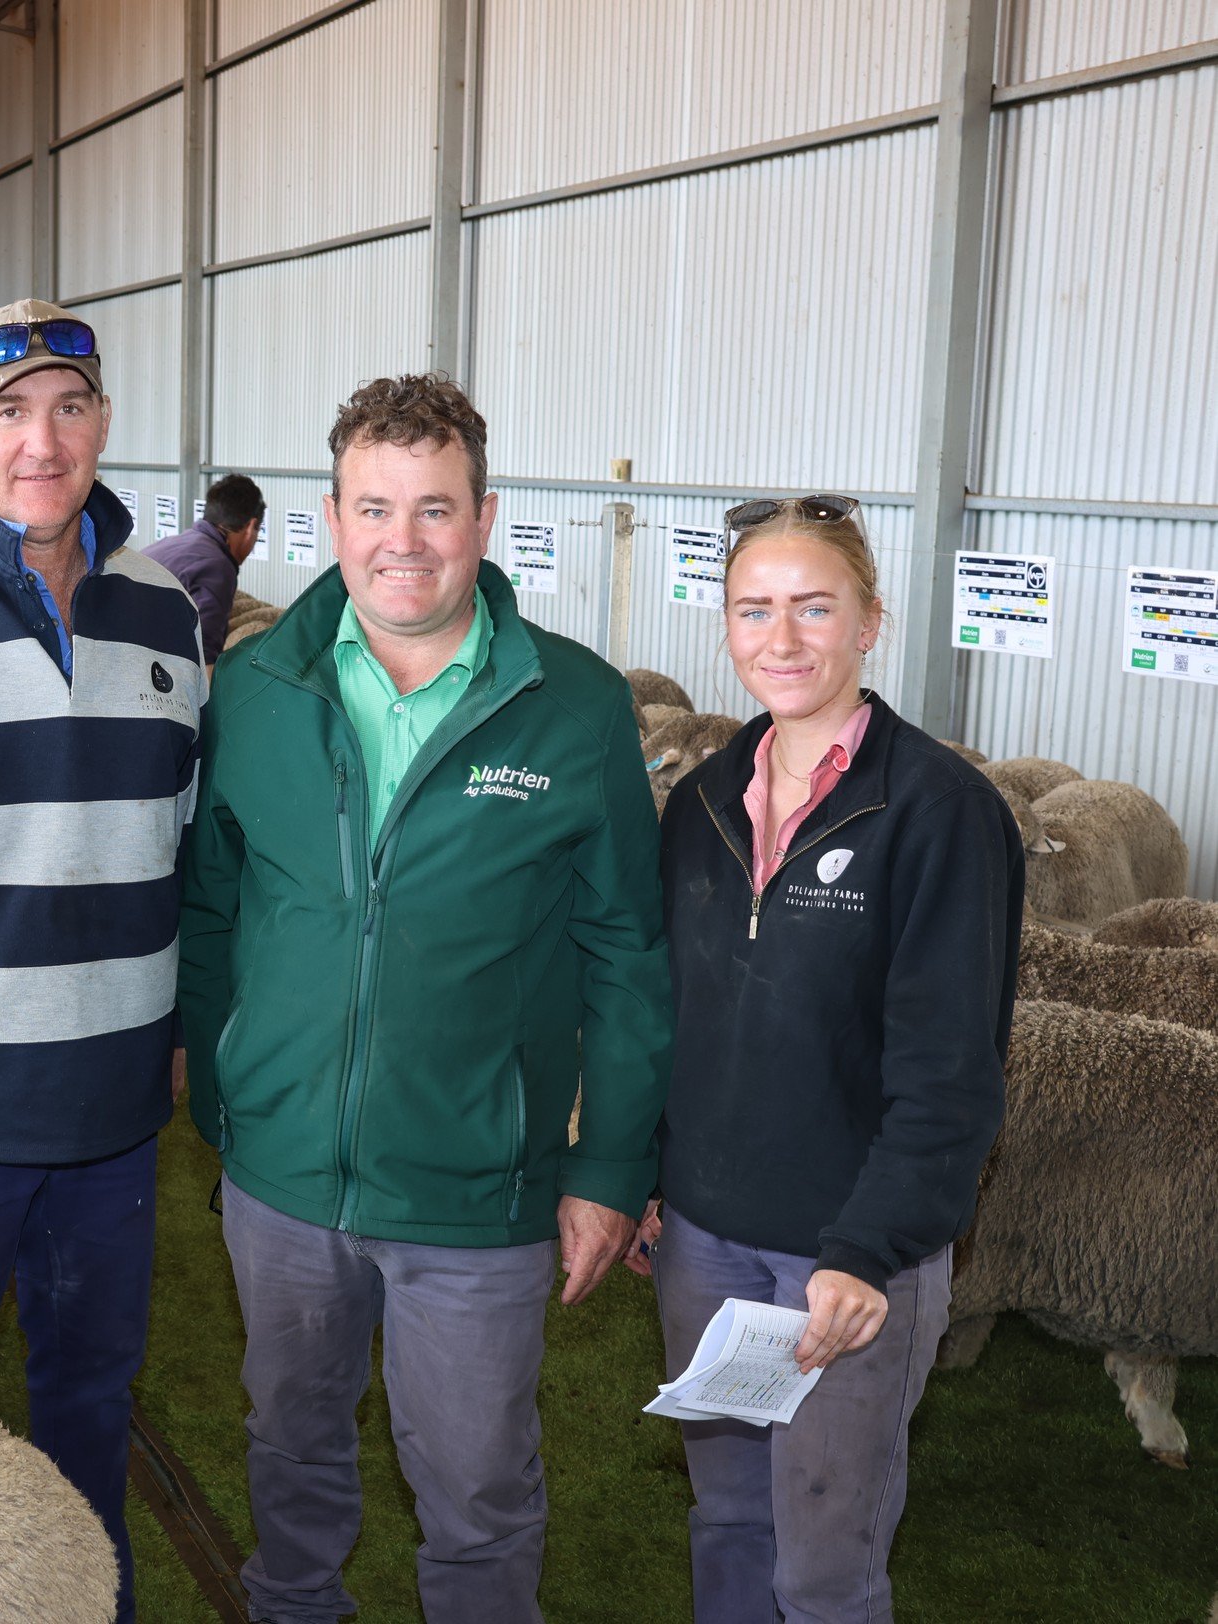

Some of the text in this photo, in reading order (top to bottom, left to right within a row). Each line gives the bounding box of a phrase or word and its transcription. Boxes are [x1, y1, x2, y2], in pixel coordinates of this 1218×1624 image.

[962, 628, 978, 637] Nutrien
[1134, 651, 1154, 660] Nutrien
[468, 765, 551, 790] Nutrien
[463, 784, 529, 800] Ag Solutions
[834, 889, 865, 900] FARMS
[786, 898, 836, 908] ESTABLISHED
